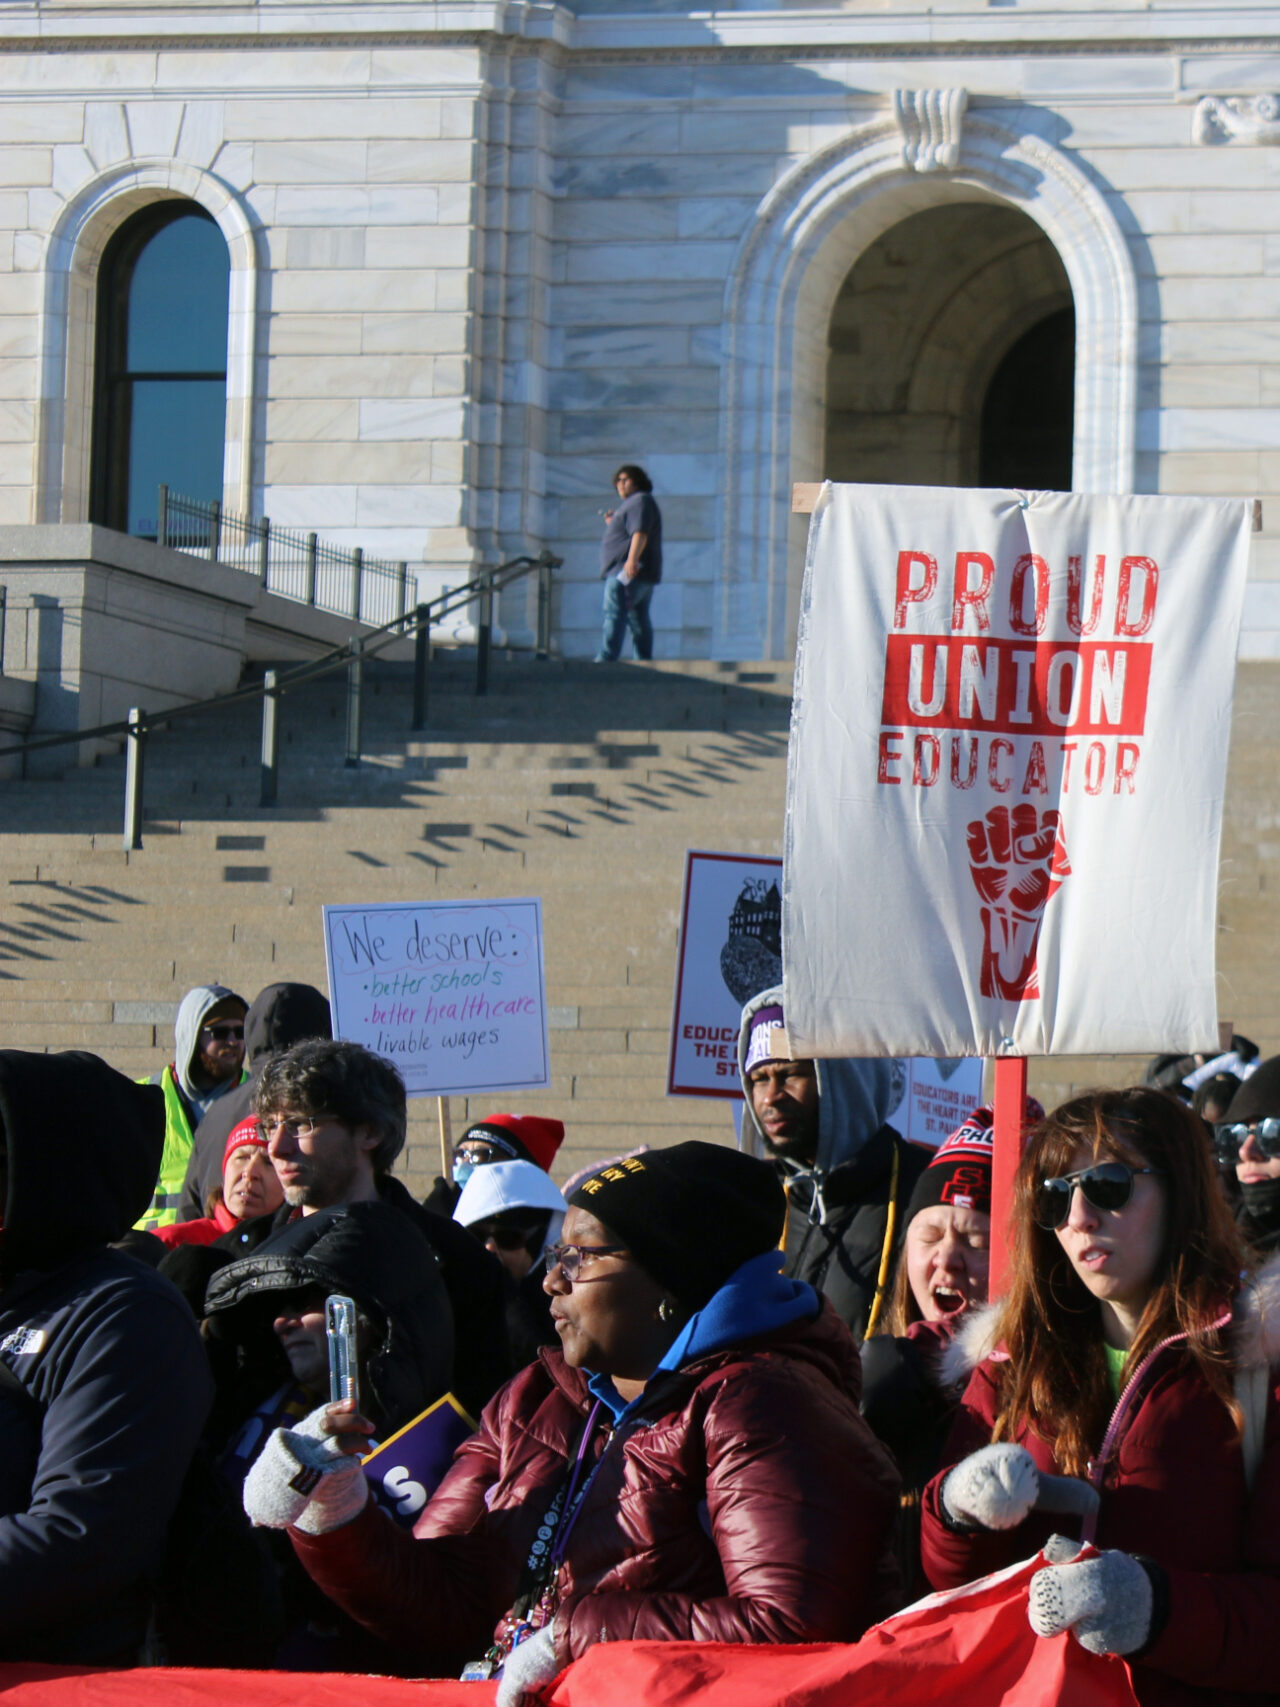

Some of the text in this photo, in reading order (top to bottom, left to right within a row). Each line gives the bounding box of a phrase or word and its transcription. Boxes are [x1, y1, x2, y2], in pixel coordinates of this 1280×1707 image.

[894, 551, 1159, 636] PROUD
[907, 644, 1127, 727] UNION
[877, 732, 1140, 796] EDUCATOR
[342, 915, 519, 967] We deserve:
[371, 961, 503, 998] better schools
[372, 992, 536, 1025] better healthcare
[376, 1028, 500, 1060] livable wages
[694, 1043, 728, 1059] THE
[913, 1082, 977, 1108] EDUCATORS ARE
[917, 1100, 931, 1114] THE
[933, 1104, 958, 1121] HEART
